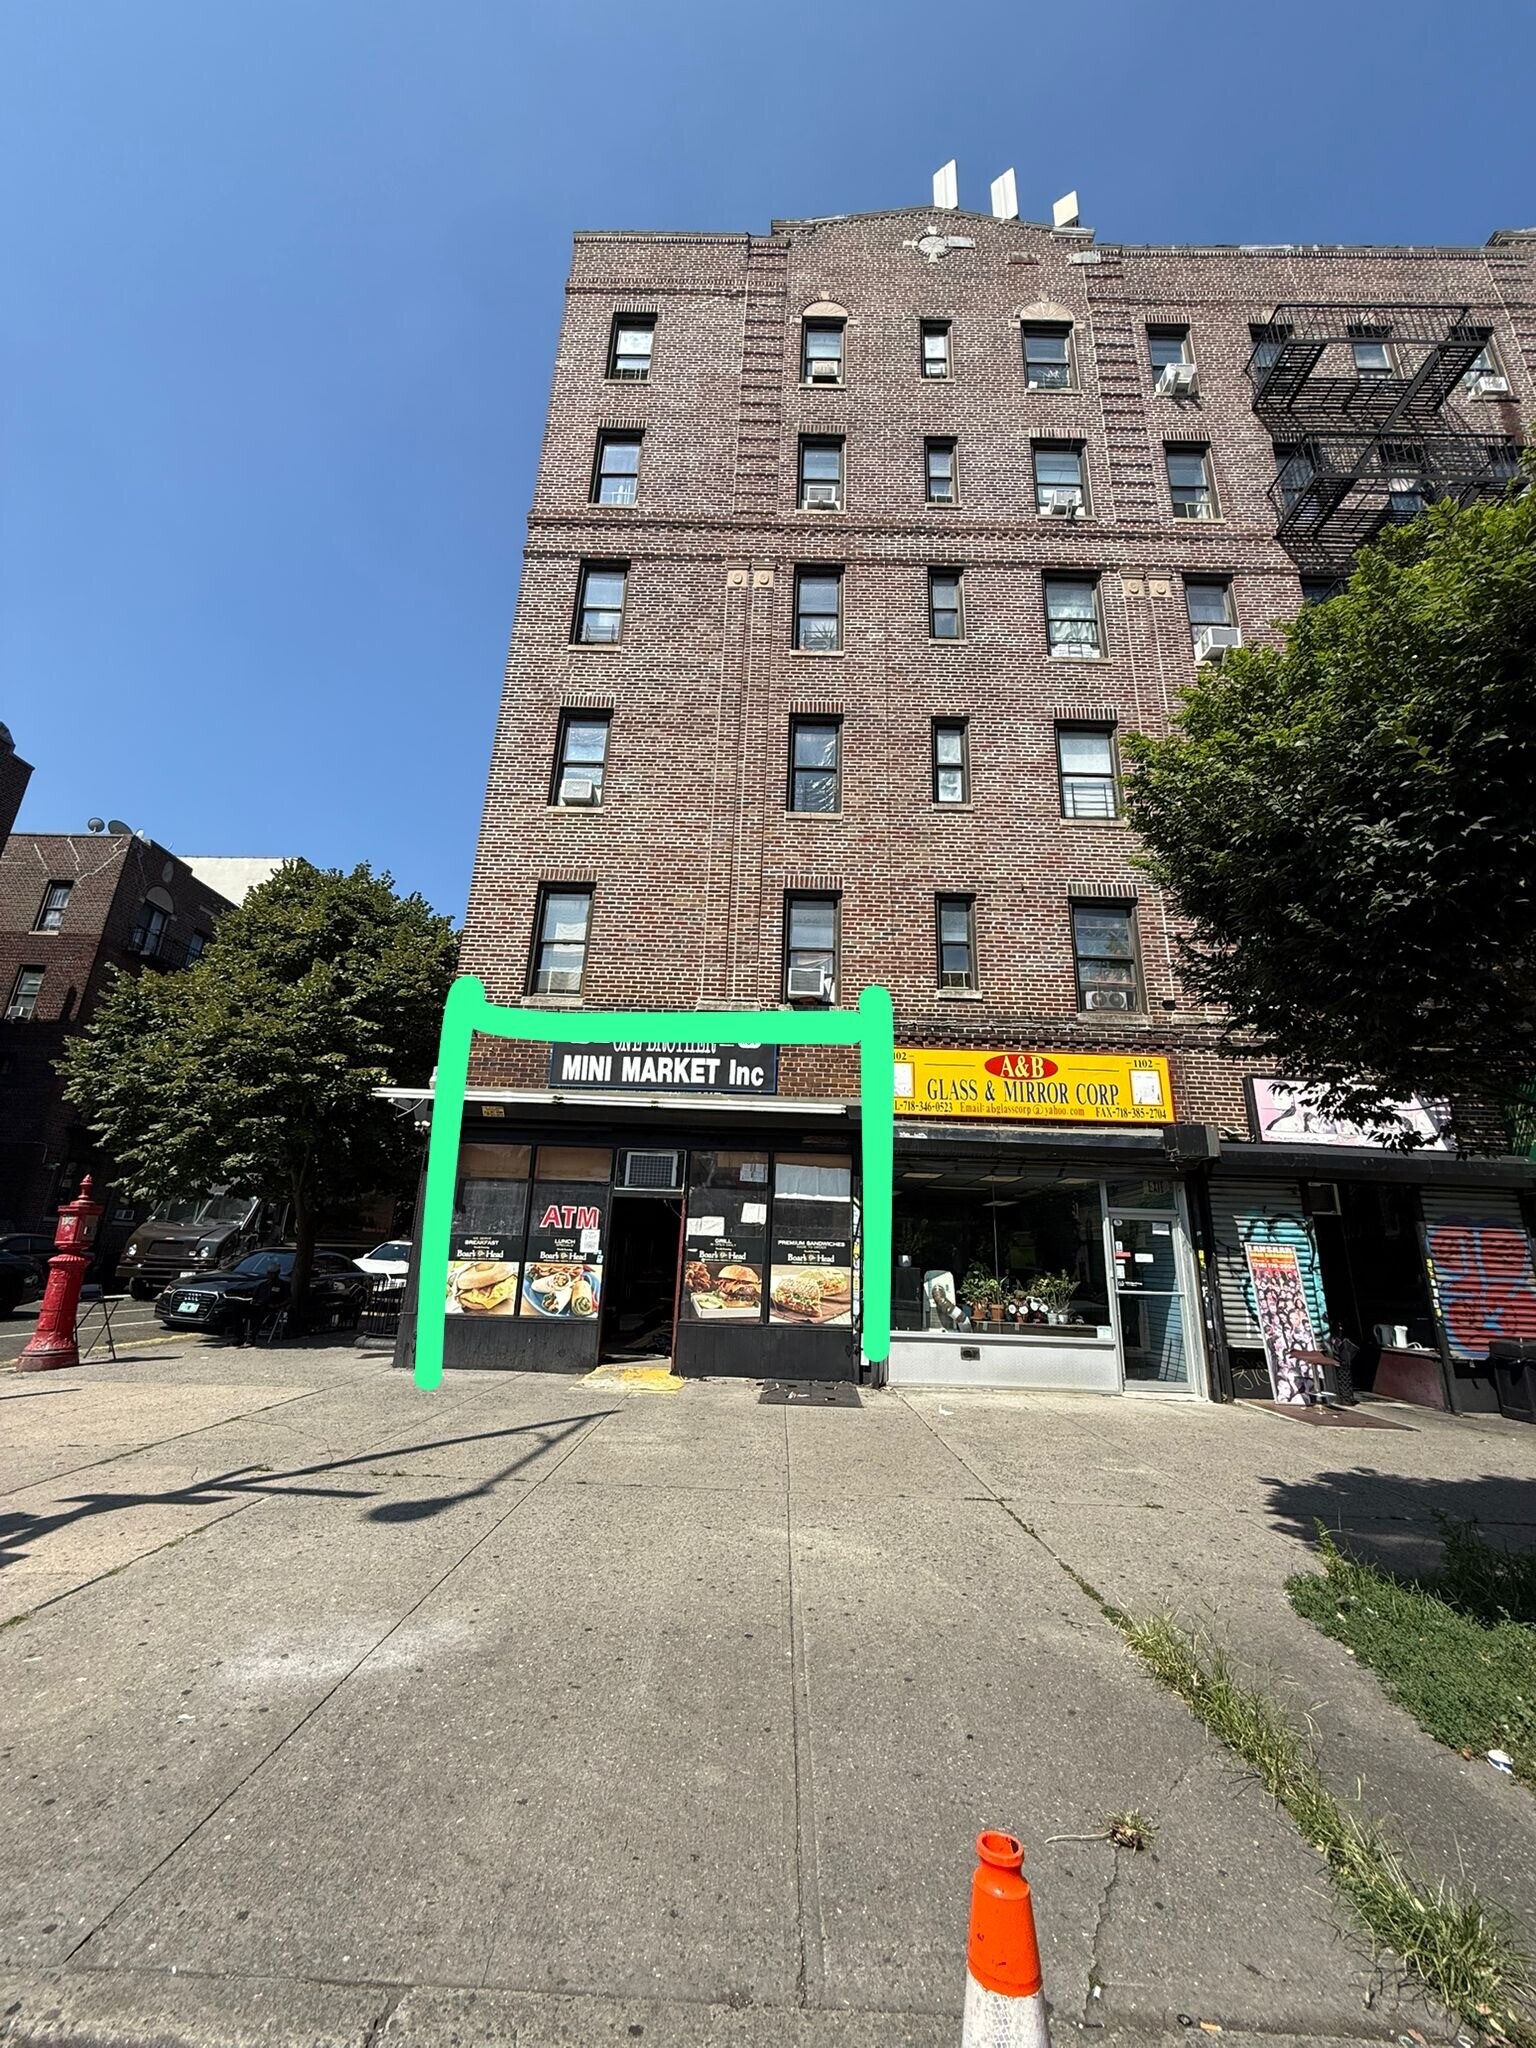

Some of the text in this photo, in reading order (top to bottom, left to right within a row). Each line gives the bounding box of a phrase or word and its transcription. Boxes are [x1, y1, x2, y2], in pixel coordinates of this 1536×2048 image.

[1000, 1054, 1044, 1079] A&B
[1133, 1059, 1153, 1068] 1102
[561, 1054, 764, 1087] MINI MARKET Inc
[927, 1078, 1120, 1106] GLASS & MIRROR CORP.
[539, 1205, 600, 1230] ATM
[485, 1250, 504, 1258] Head
[569, 1252, 587, 1260] Head
[728, 1251, 747, 1260] Head
[817, 1254, 835, 1262] Head
